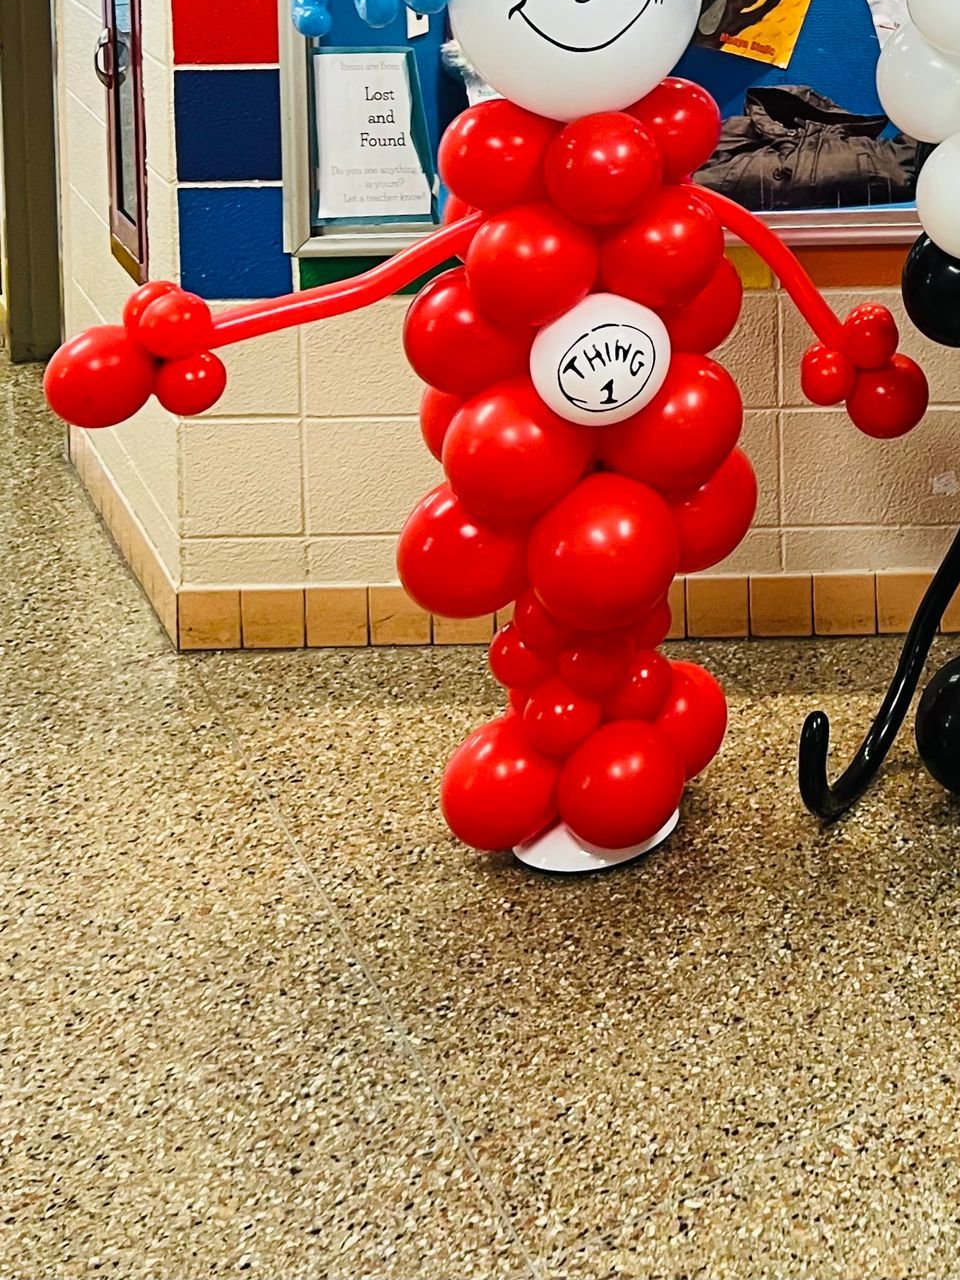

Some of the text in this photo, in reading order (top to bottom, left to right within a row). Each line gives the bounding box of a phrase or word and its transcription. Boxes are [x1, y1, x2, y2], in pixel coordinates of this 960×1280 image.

[364, 86, 396, 101] Lost
[367, 109, 396, 124] and
[360, 132, 407, 147] Found
[562, 339, 645, 379] THING
[600, 378, 618, 404] 1
